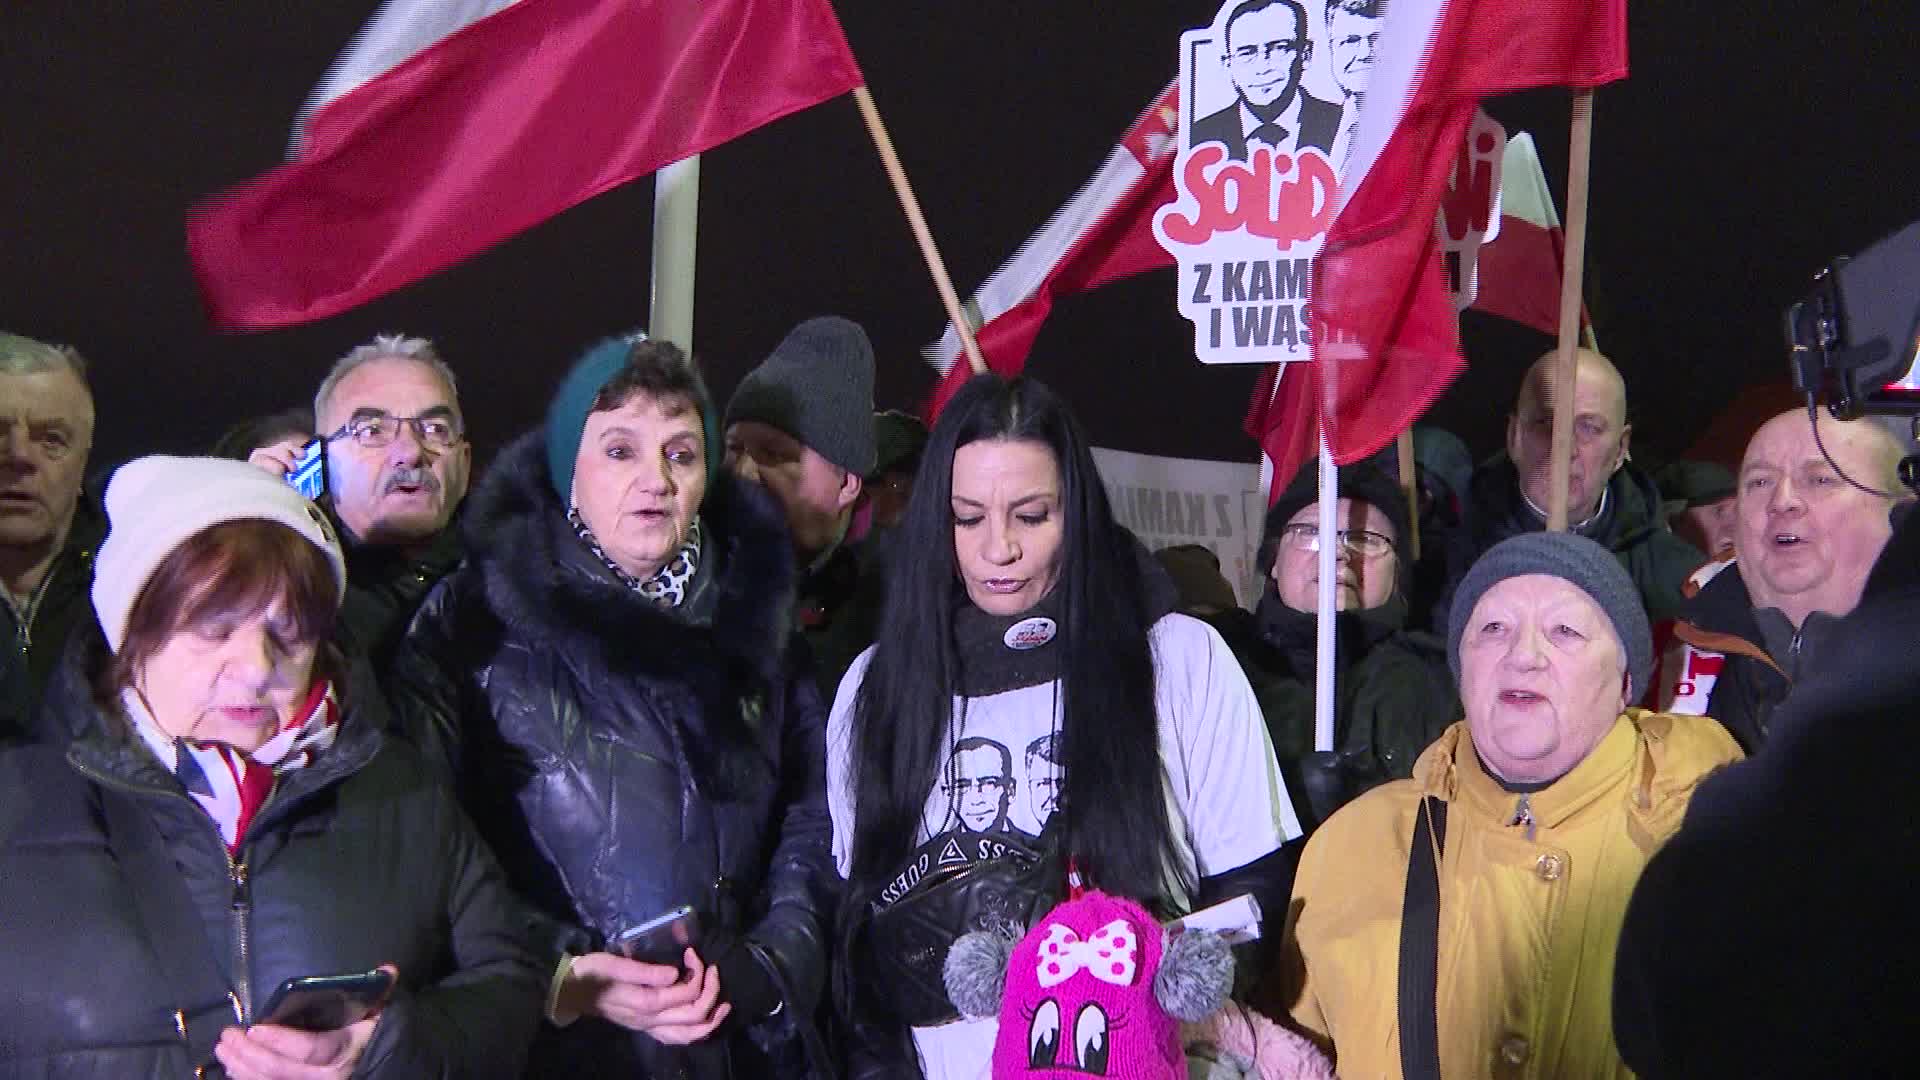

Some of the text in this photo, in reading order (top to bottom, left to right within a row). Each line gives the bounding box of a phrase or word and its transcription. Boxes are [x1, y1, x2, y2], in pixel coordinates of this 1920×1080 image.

[1193, 258, 1311, 303] Z KAM
[1210, 304, 1312, 353] I WĄS
[881, 853, 929, 904] GUESS
